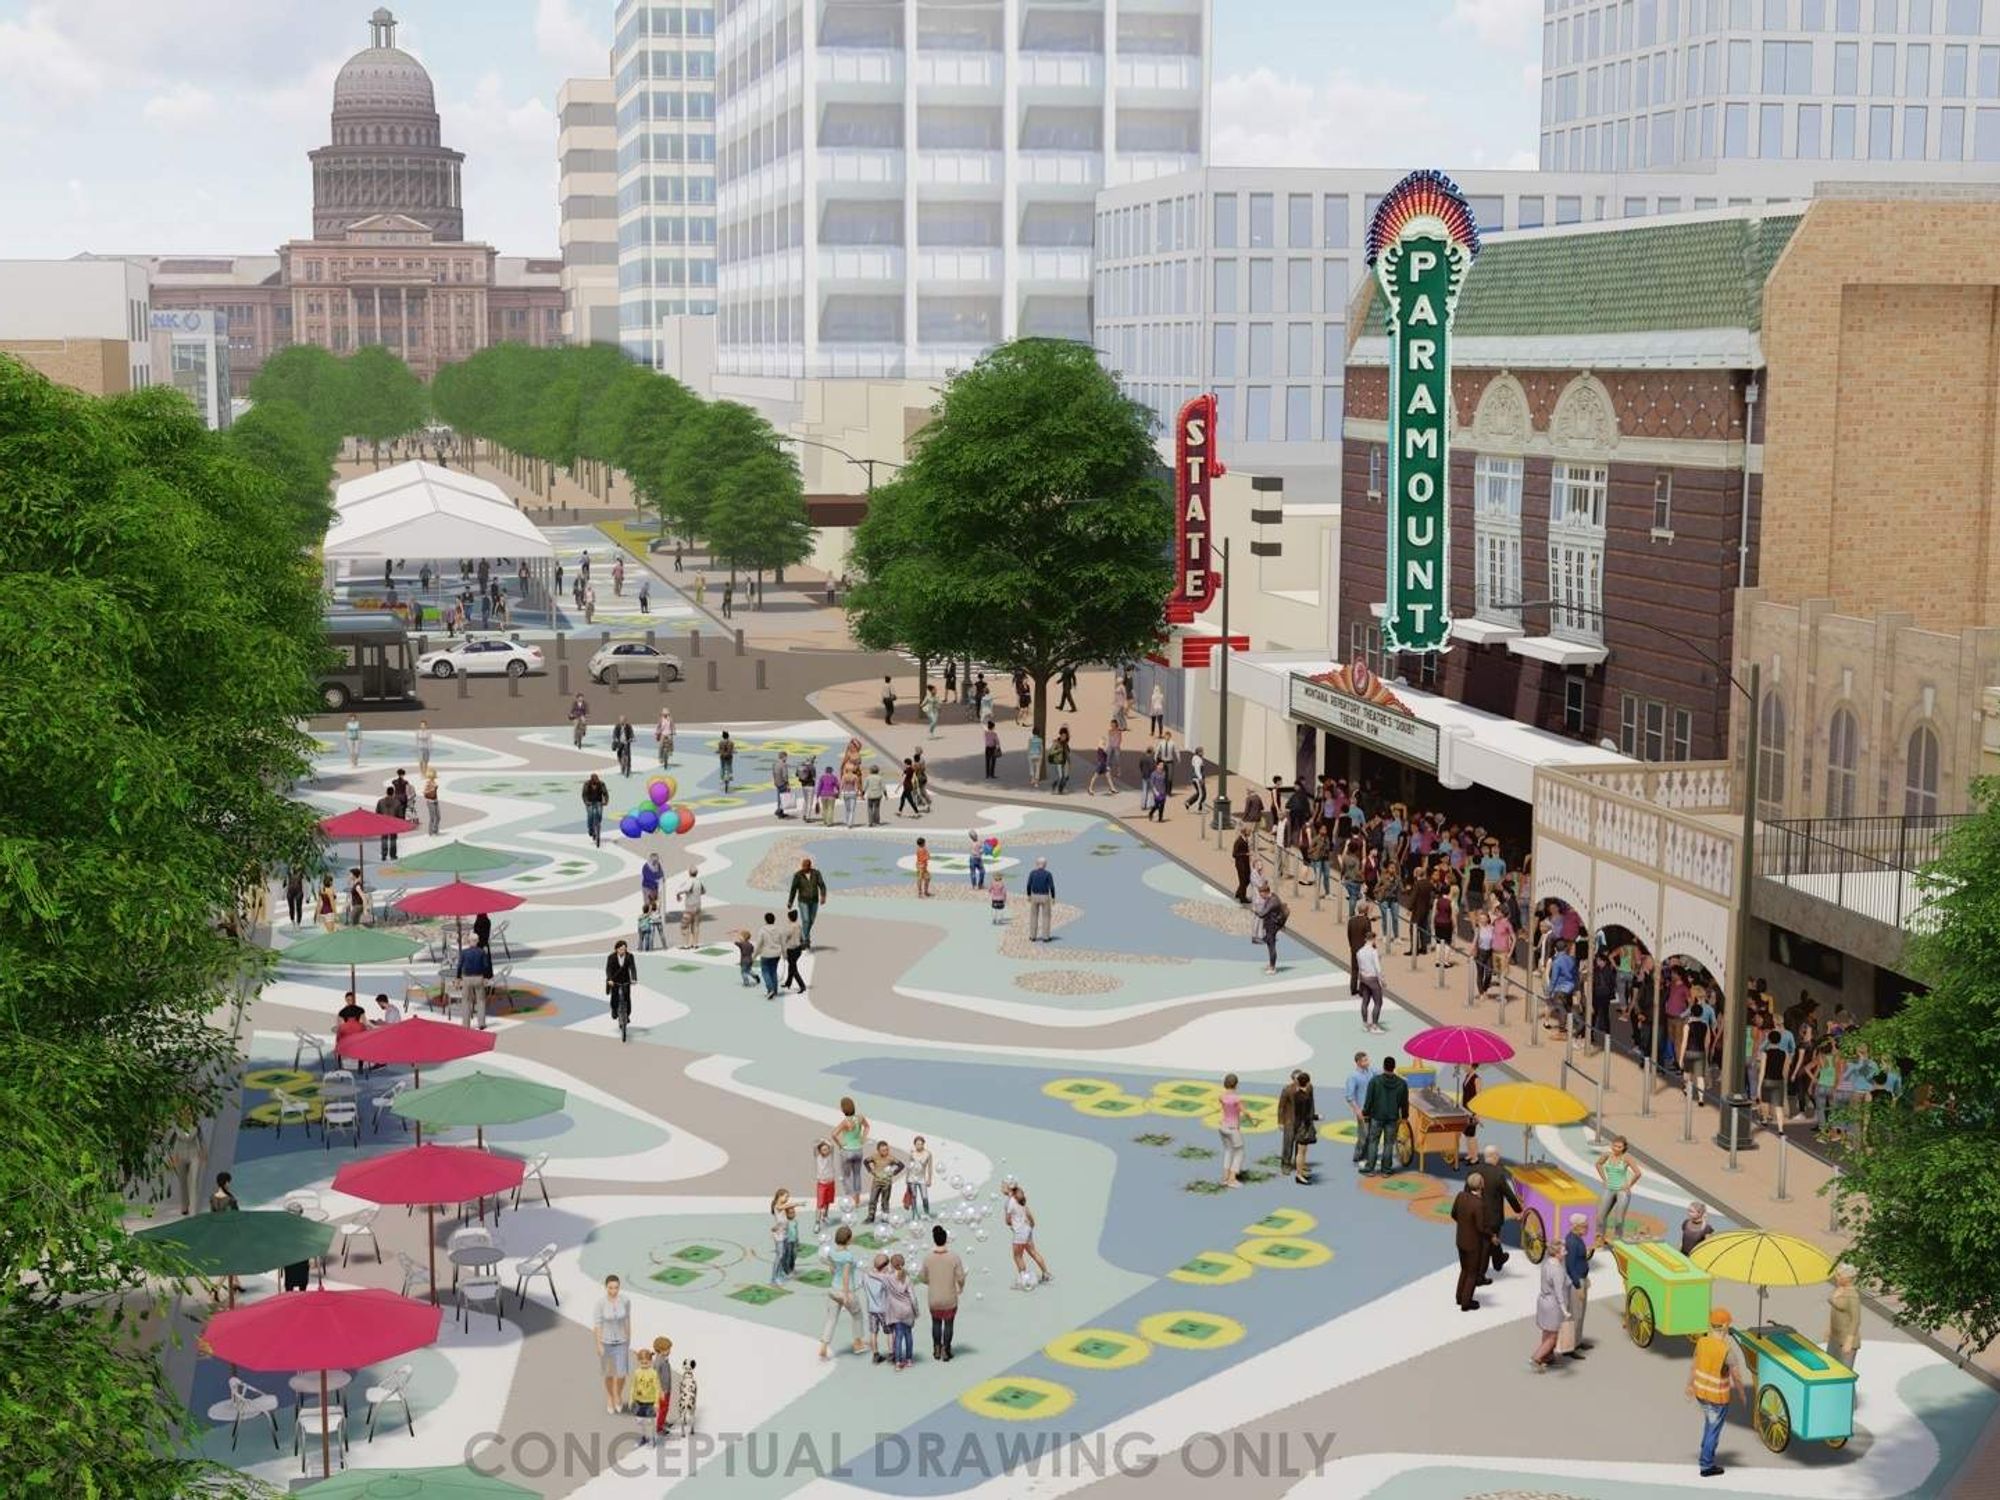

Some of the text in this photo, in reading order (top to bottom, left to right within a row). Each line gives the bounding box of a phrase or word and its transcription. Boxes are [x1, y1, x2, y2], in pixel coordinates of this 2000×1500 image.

[150, 313, 180, 329] NK
[1405, 251, 1438, 633] PARAMOUNT
[1186, 419, 1205, 597] STATE
[1304, 687, 1328, 703] MONTANA
[1330, 695, 1361, 715] REPERTORY
